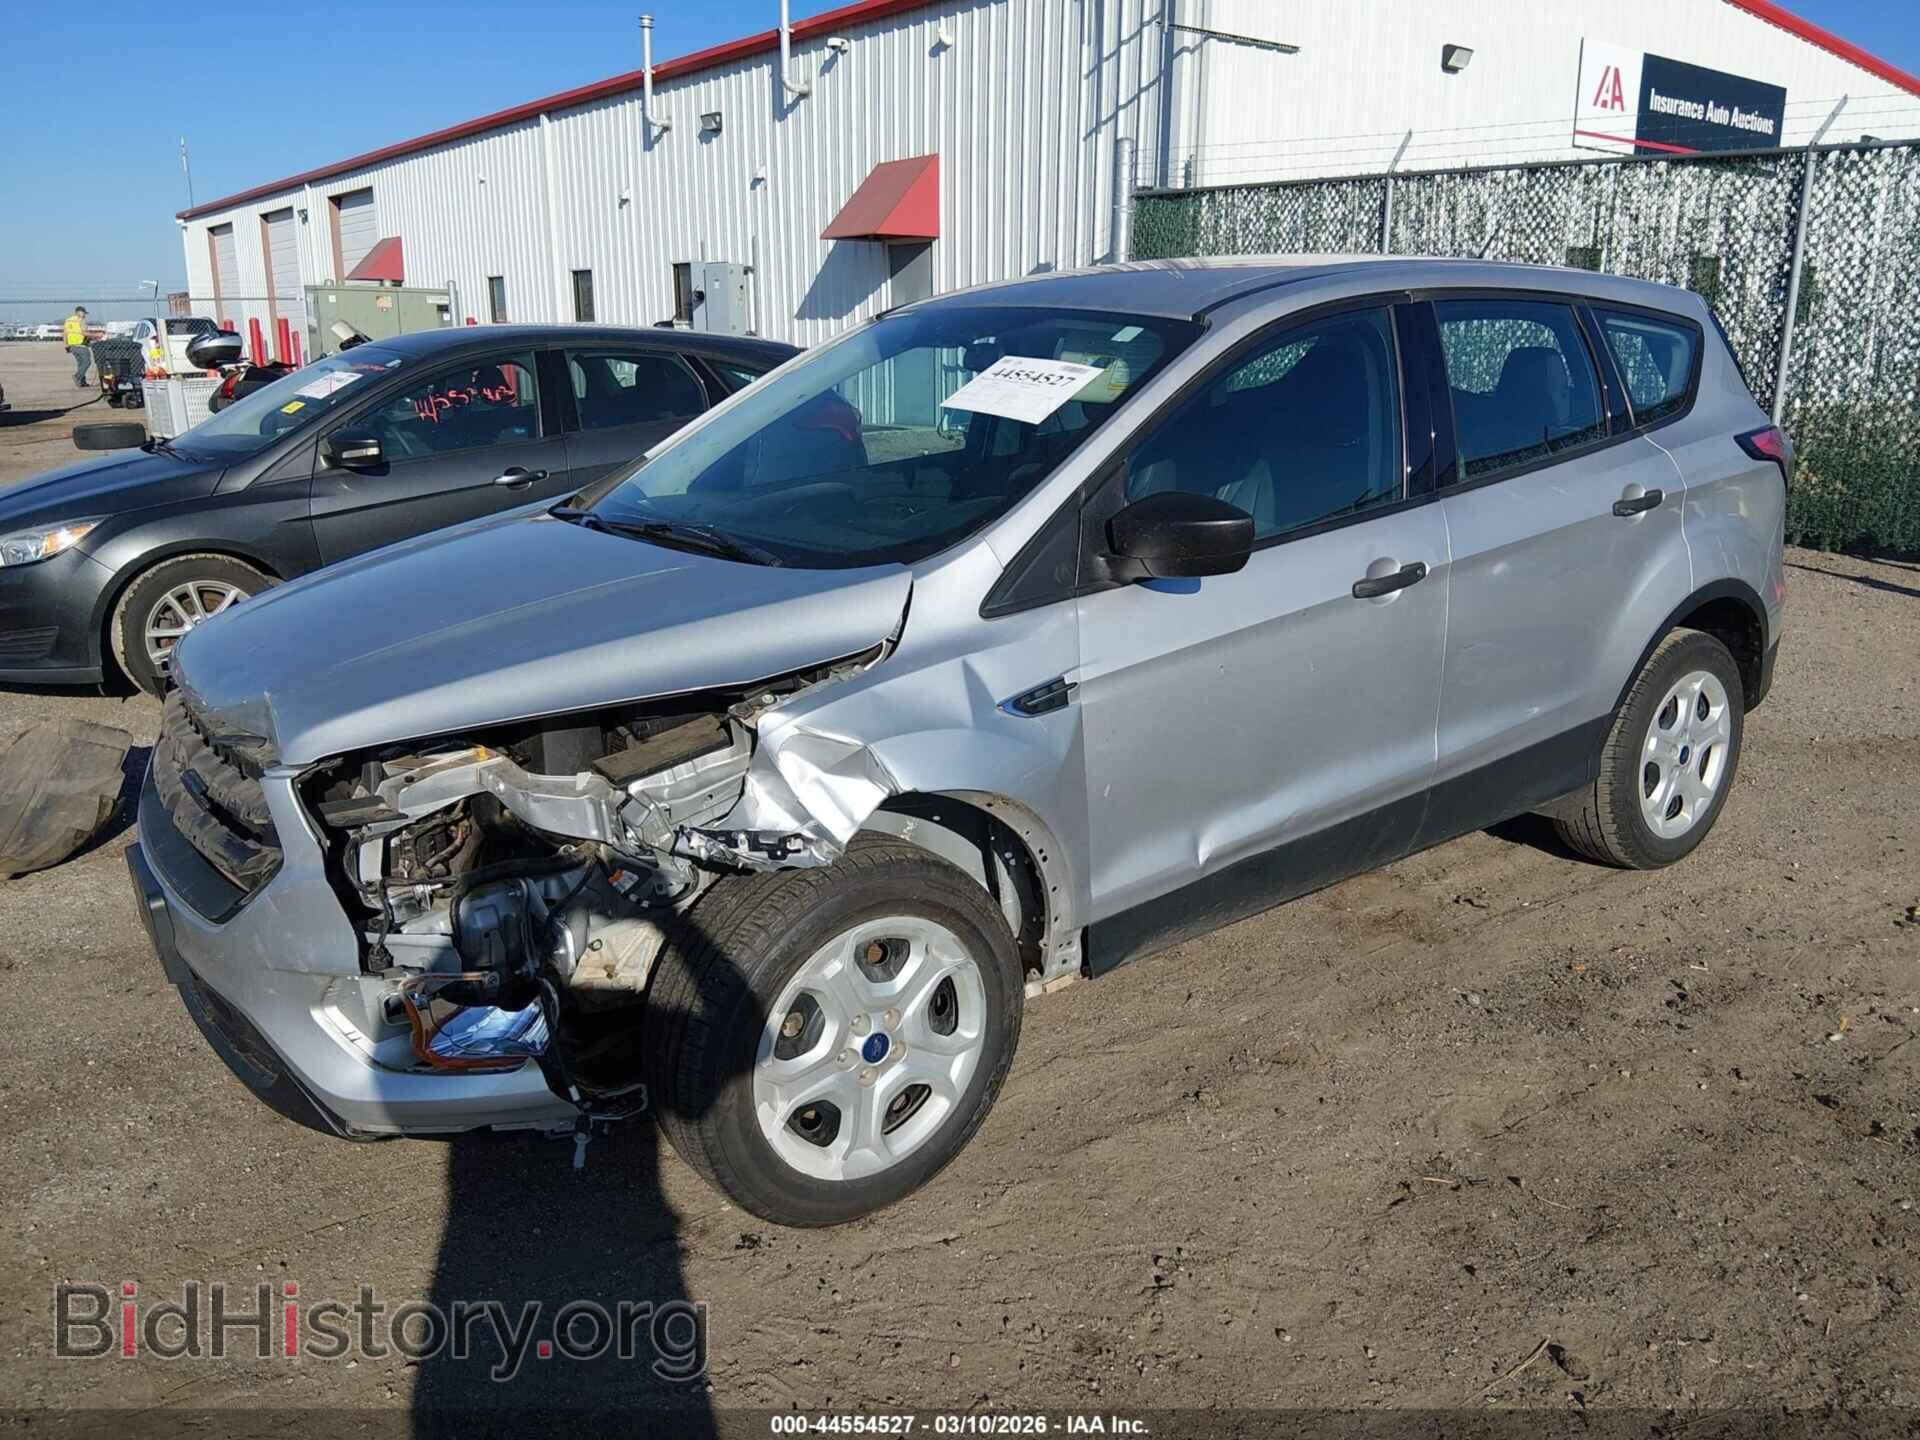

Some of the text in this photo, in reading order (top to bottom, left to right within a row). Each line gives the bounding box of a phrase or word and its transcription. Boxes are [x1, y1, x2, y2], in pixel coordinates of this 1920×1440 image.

[1649, 87, 1774, 135] Insurance Auto Auctions
[992, 368, 1077, 387] 44554527
